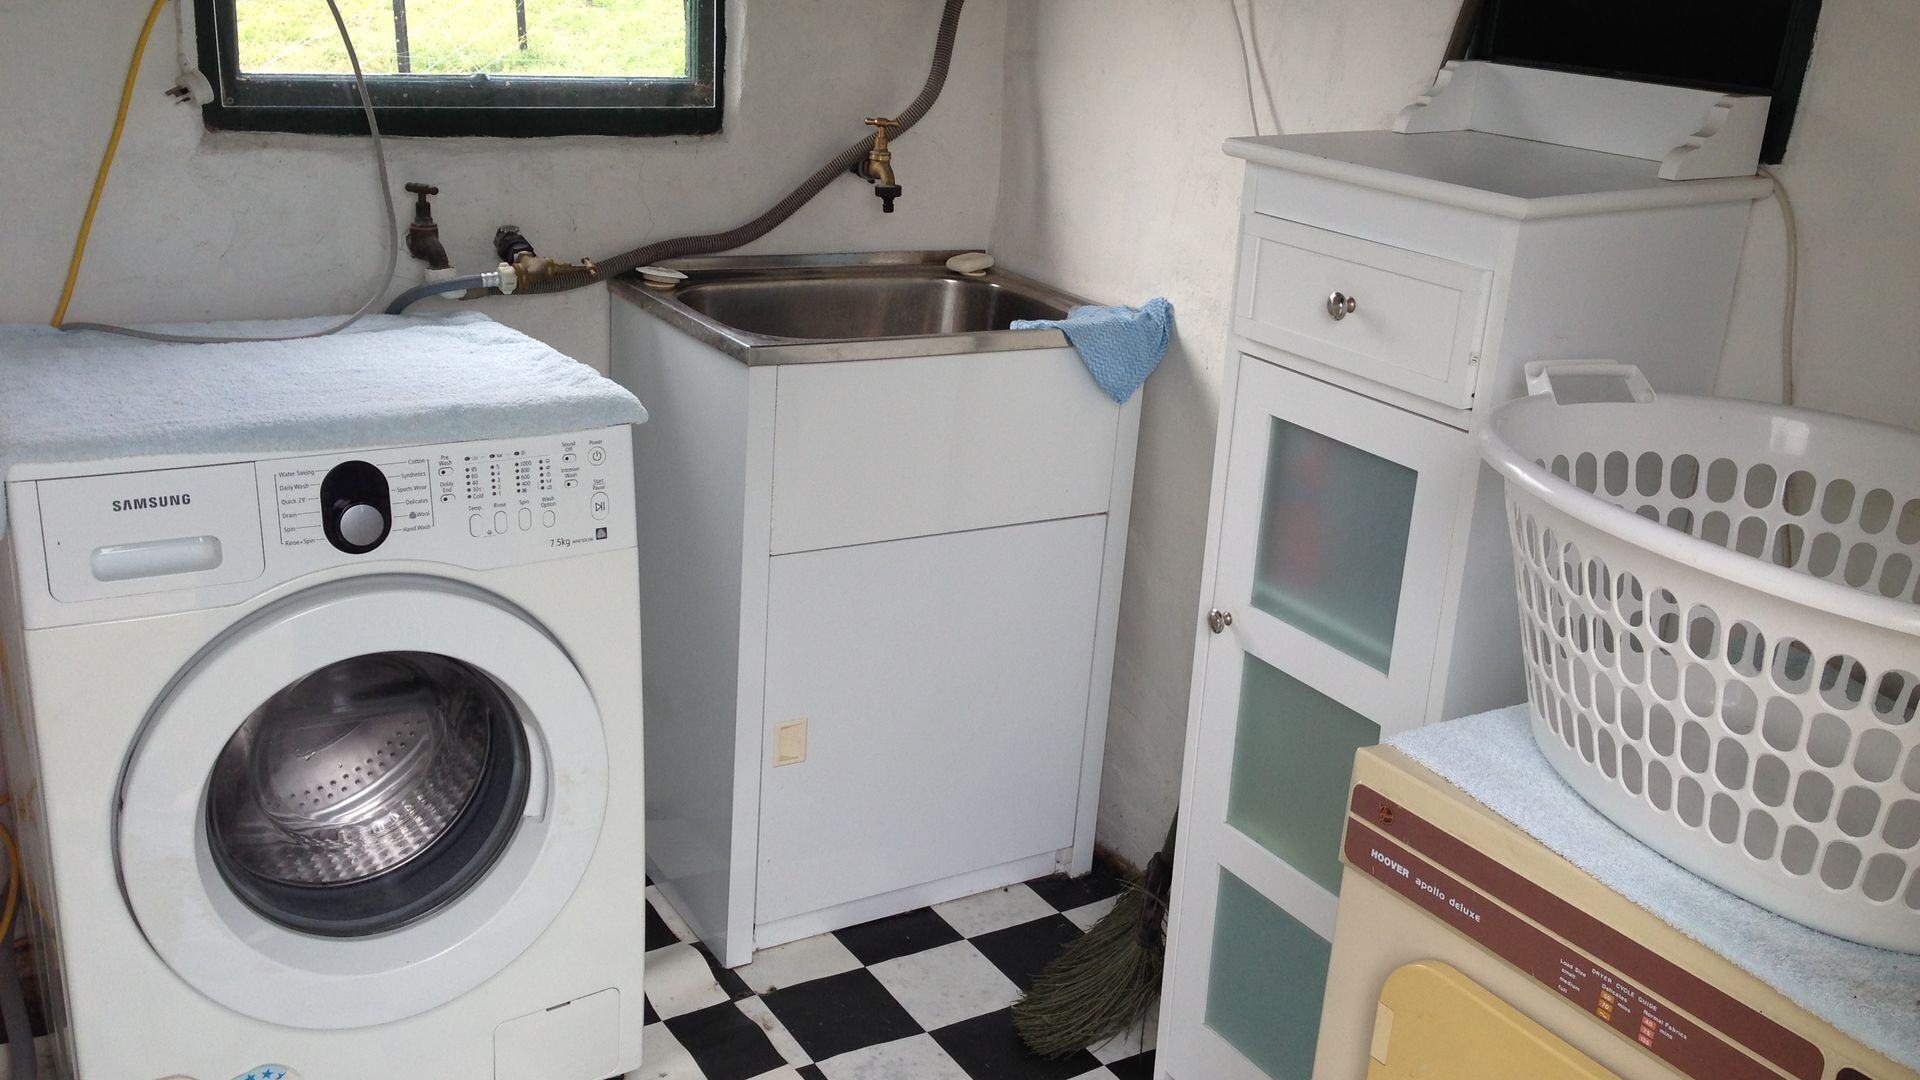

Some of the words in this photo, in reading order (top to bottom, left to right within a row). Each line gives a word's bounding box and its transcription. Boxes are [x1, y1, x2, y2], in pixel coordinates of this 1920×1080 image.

[112, 494, 191, 512] SAMSUNG
[550, 538, 570, 547] 7.5kg
[1370, 848, 1410, 878] HOOVER
[1415, 877, 1446, 900] apollo
[1448, 898, 1481, 922] deluxe
[1560, 958, 1574, 970] Load
[1574, 967, 1587, 978] Size
[1561, 968, 1576, 980] small
[1558, 984, 1568, 994] full
[1559, 976, 1580, 992] medium
[1591, 968, 1613, 984] DRYER
[1616, 983, 1636, 998] CYCLE
[1638, 996, 1658, 1012] GUIDE
[1601, 983, 1628, 1003] Delicates
[1617, 1001, 1631, 1014] mins
[1643, 1009, 1664, 1025] Normal
[1664, 1022, 1688, 1040] Fabrics
[1659, 1028, 1673, 1040] mins
